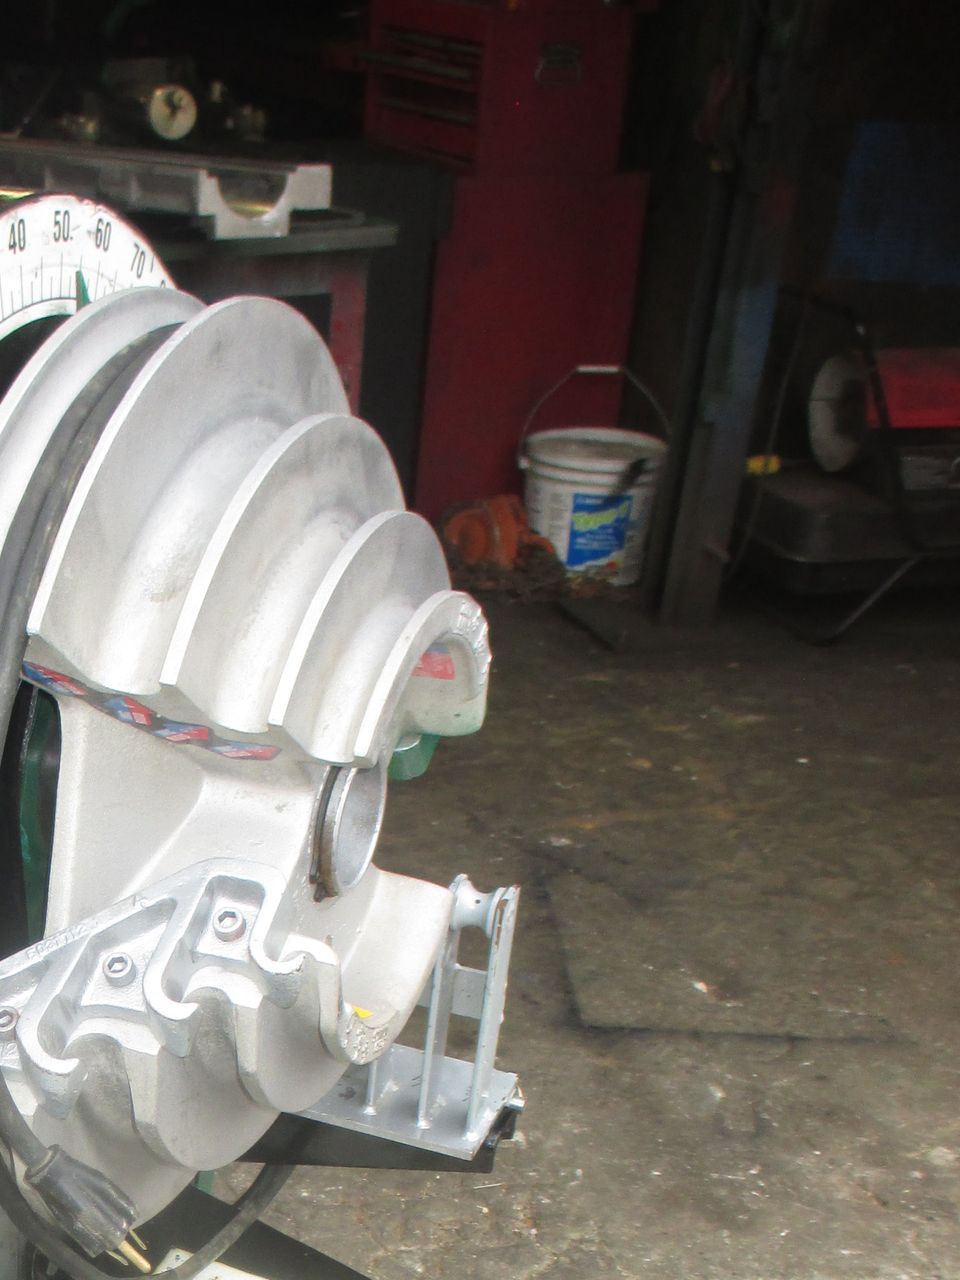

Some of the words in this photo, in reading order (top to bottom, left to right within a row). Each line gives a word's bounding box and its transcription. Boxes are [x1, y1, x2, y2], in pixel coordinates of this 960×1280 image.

[8, 219, 26, 253] 40
[53, 210, 71, 242] 50
[95, 218, 112, 251] 60
[130, 242, 146, 279] 70
